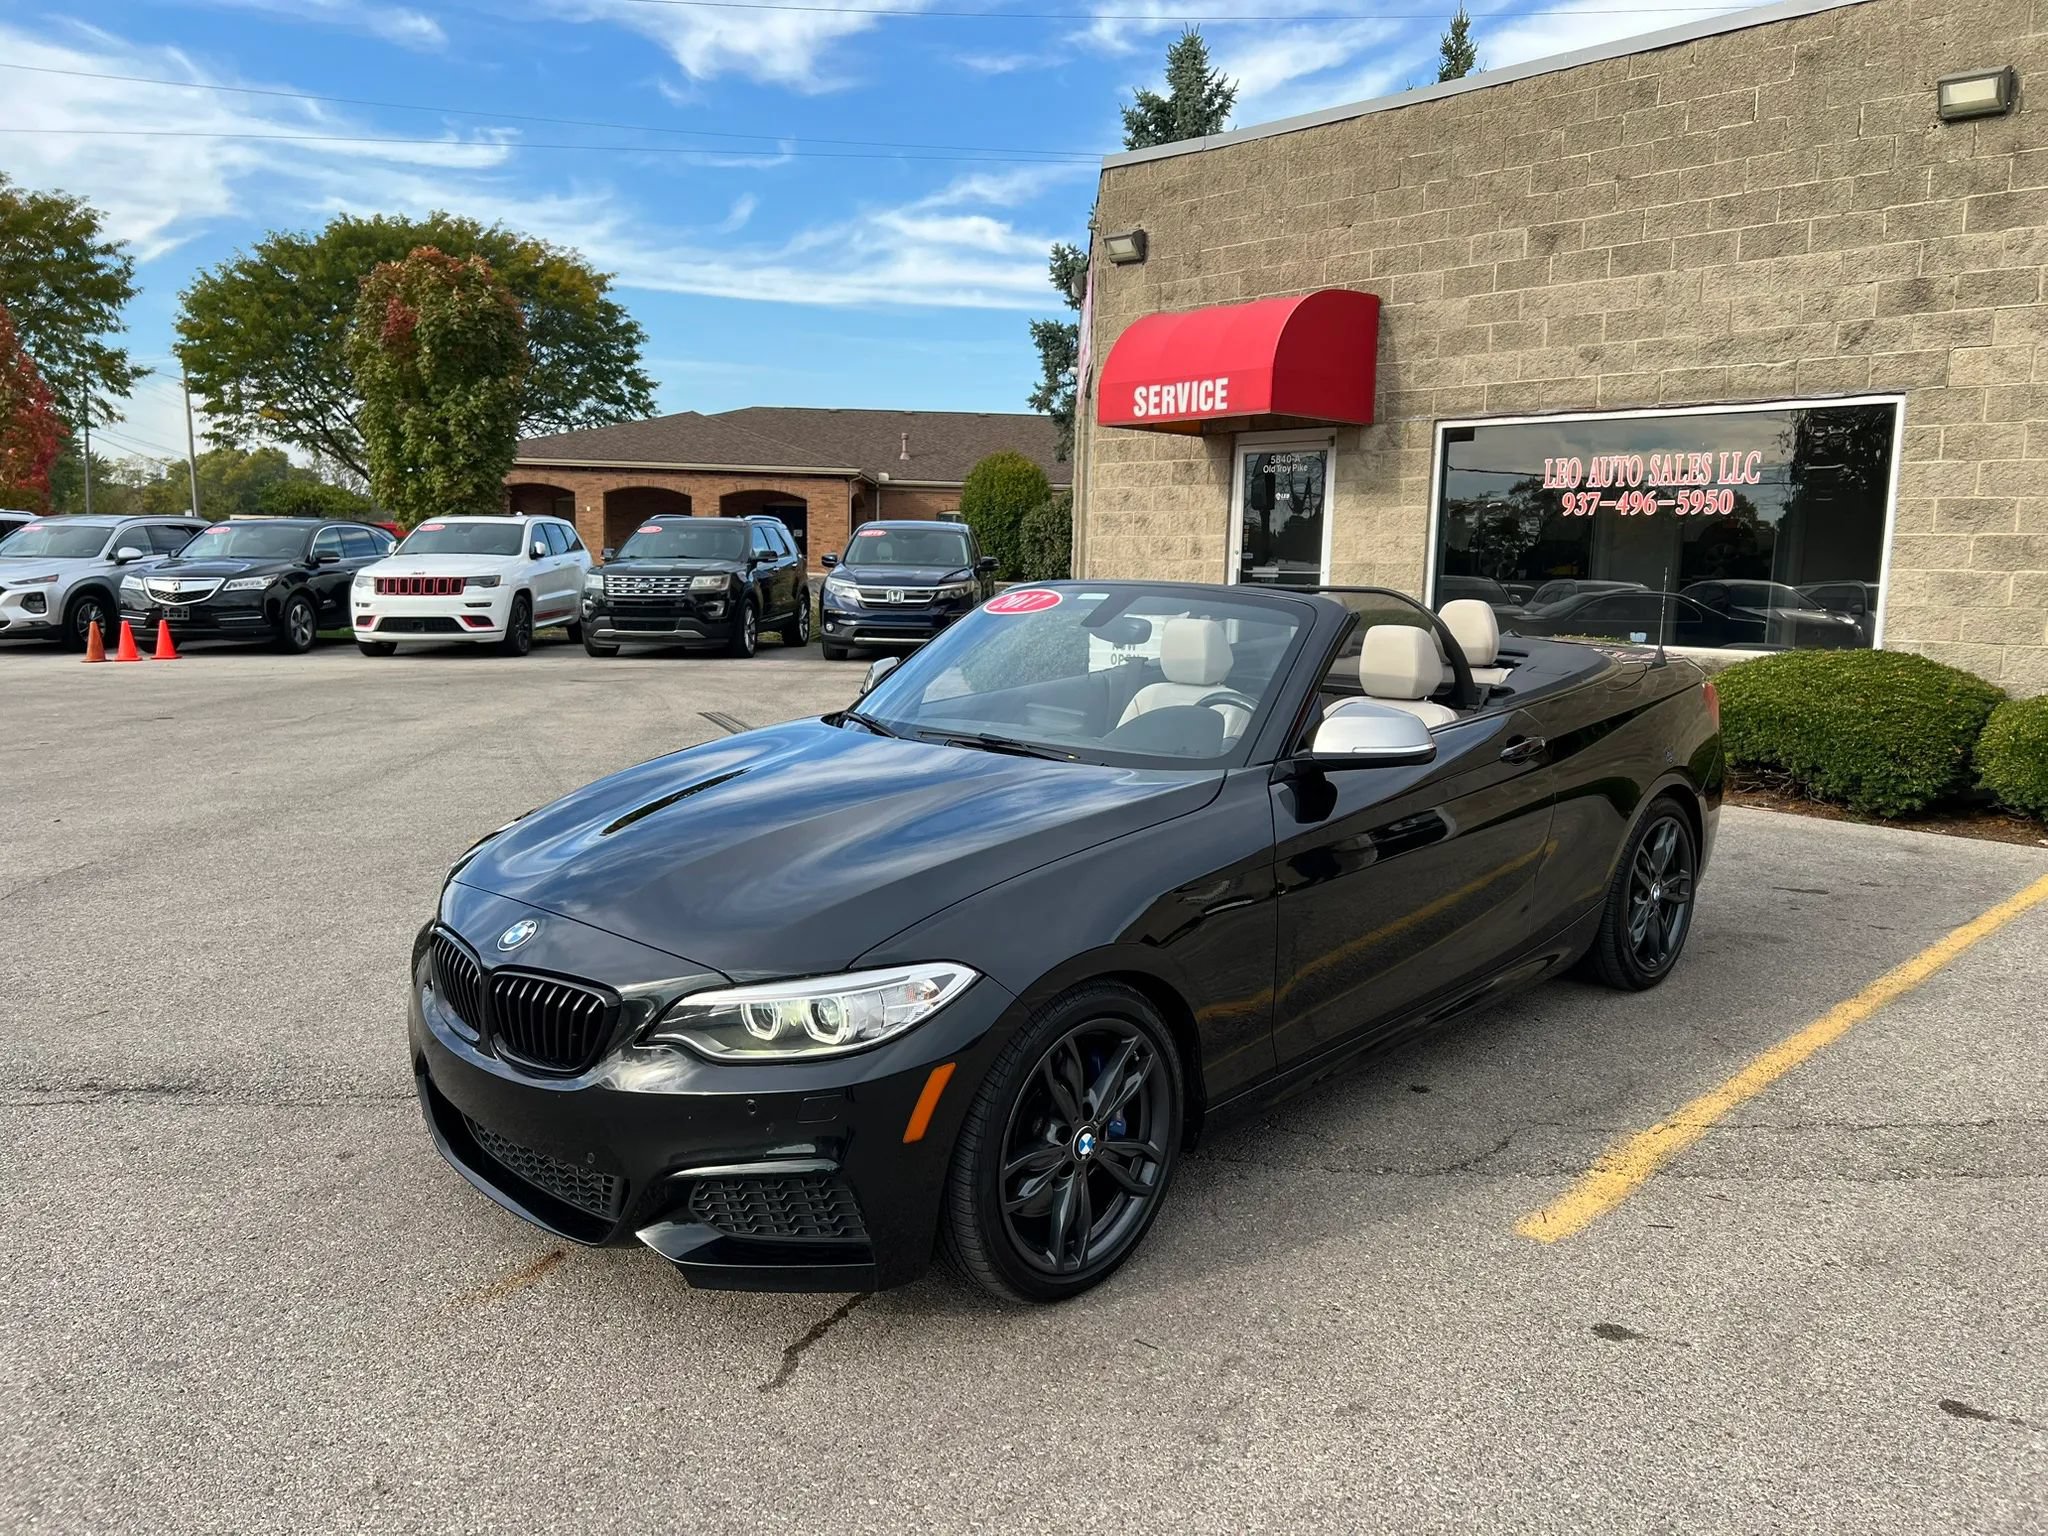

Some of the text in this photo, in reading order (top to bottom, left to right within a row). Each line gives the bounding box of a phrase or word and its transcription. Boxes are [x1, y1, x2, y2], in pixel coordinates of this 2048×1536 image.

[1133, 377, 1229, 417] SERVICE
[1262, 464, 1309, 474] Old Troy Pike
[1270, 454, 1301, 465] 5840-A
[1543, 450, 1762, 488] LEO AUTO SALES LLC
[1561, 488, 1735, 517] 937-496-5950
